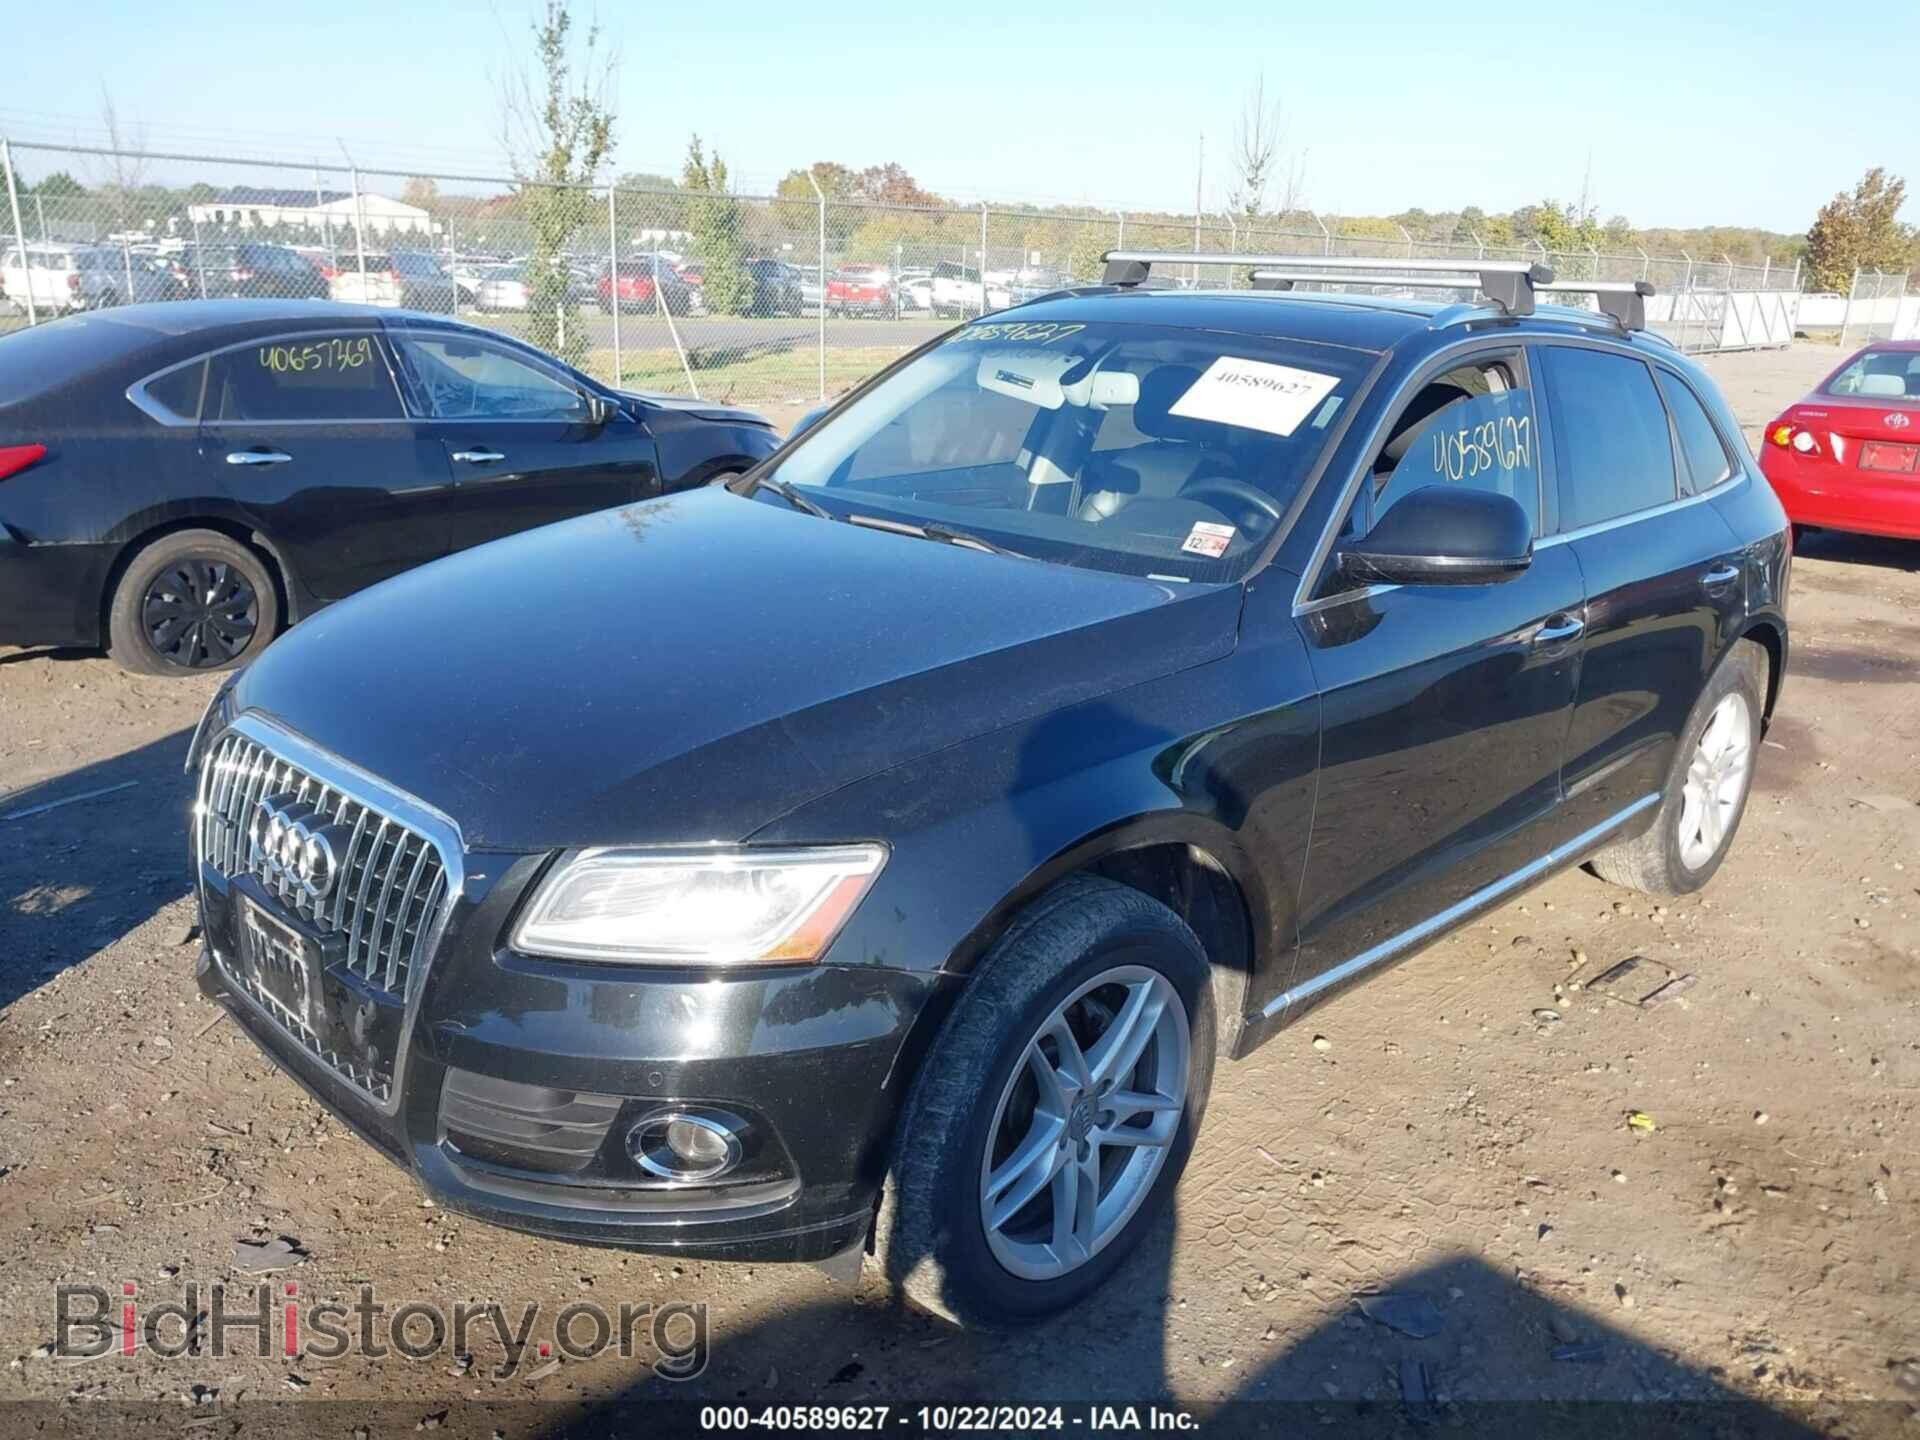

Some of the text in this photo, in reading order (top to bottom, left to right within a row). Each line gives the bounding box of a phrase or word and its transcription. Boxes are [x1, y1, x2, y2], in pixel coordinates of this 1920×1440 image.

[260, 338, 372, 372] 40657369
[1215, 370, 1312, 396] 40589627
[1433, 416, 1530, 481] 40589627
